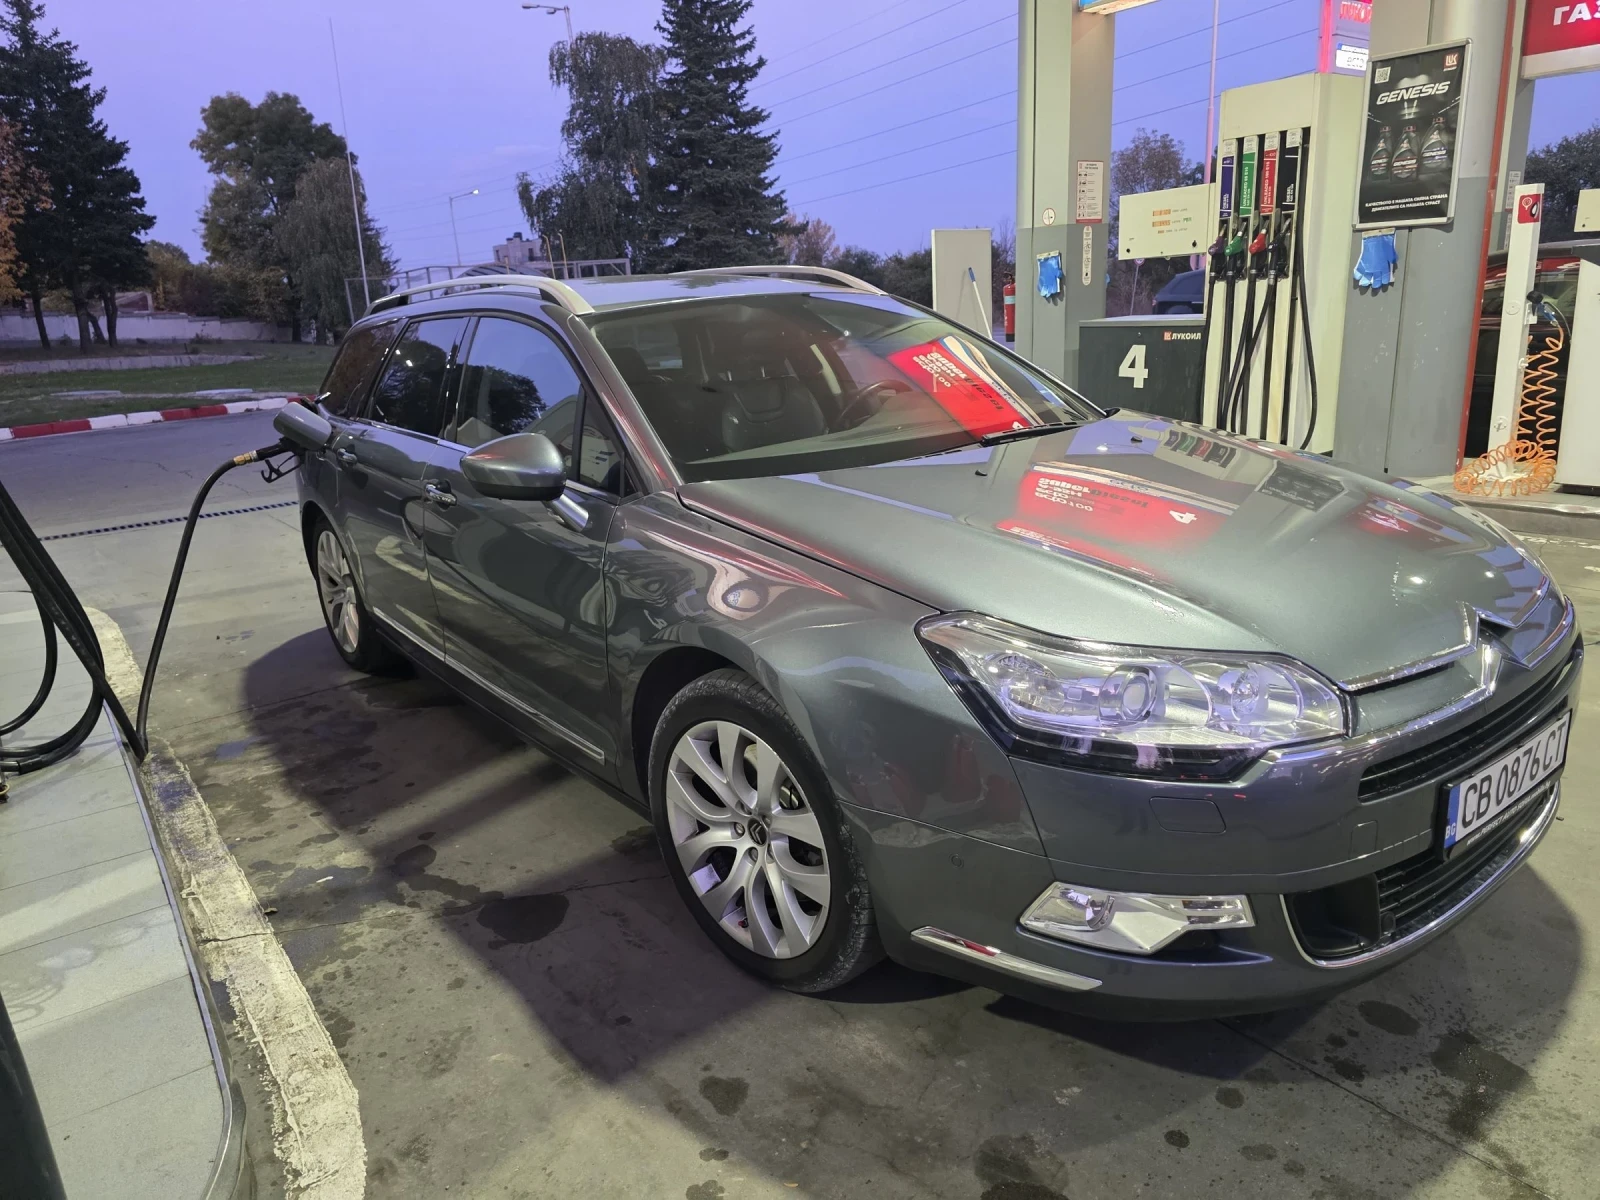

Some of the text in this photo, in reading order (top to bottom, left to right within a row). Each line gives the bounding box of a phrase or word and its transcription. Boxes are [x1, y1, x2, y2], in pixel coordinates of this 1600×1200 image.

[1376, 81, 1451, 105] GENESIS
[1118, 344, 1149, 388] 4
[1461, 720, 1567, 829] CB 0876 CT
[1445, 822, 1457, 839] BG
